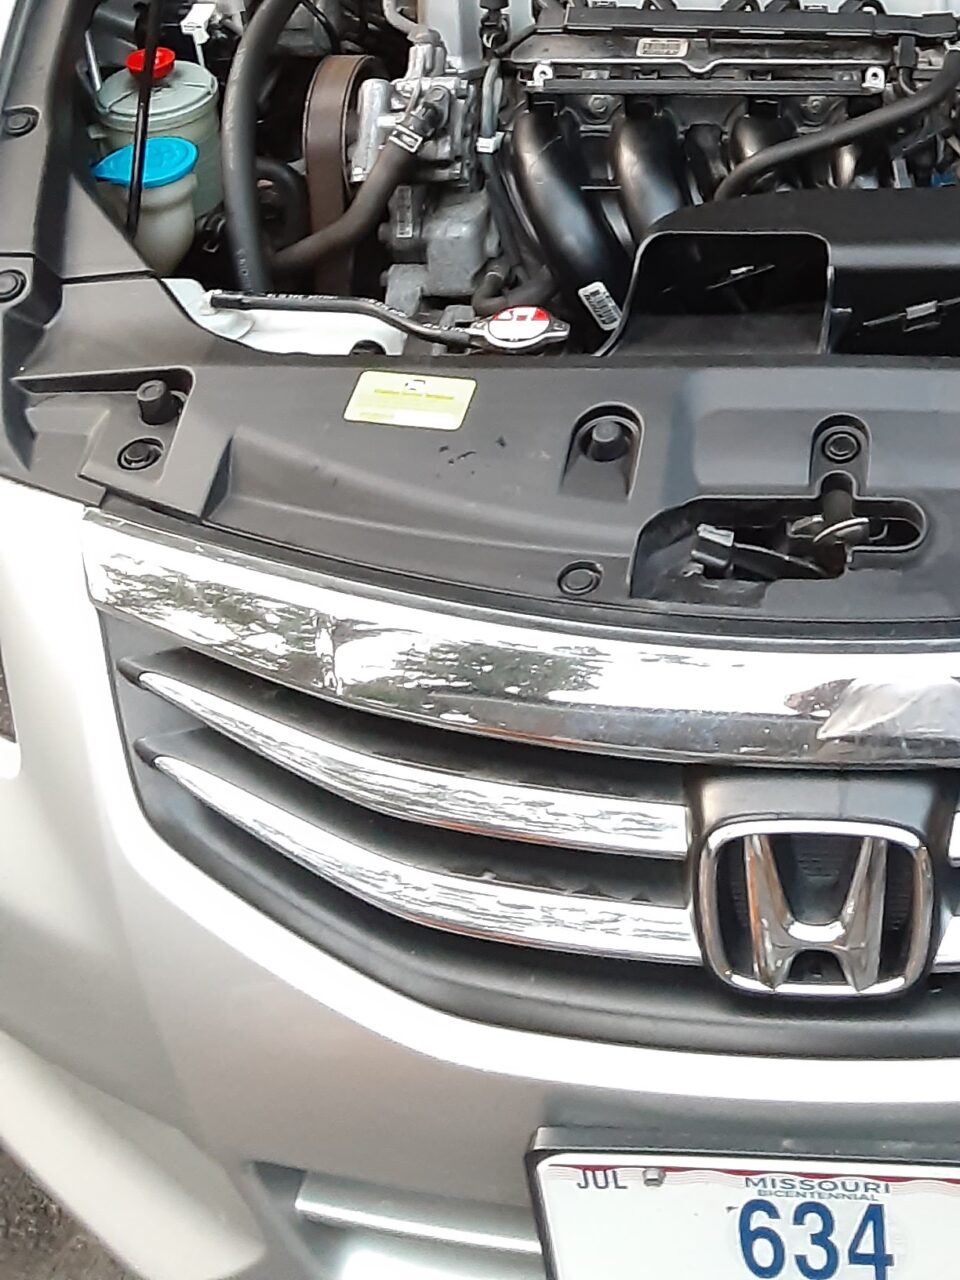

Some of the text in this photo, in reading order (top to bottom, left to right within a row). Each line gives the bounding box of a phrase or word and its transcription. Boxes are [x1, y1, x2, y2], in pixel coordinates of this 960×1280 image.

[577, 1169, 628, 1190] JUL
[745, 1177, 890, 1194] MISSOURI
[757, 1188, 879, 1201] BICENTENNIAL
[739, 1198, 895, 1280] 634
